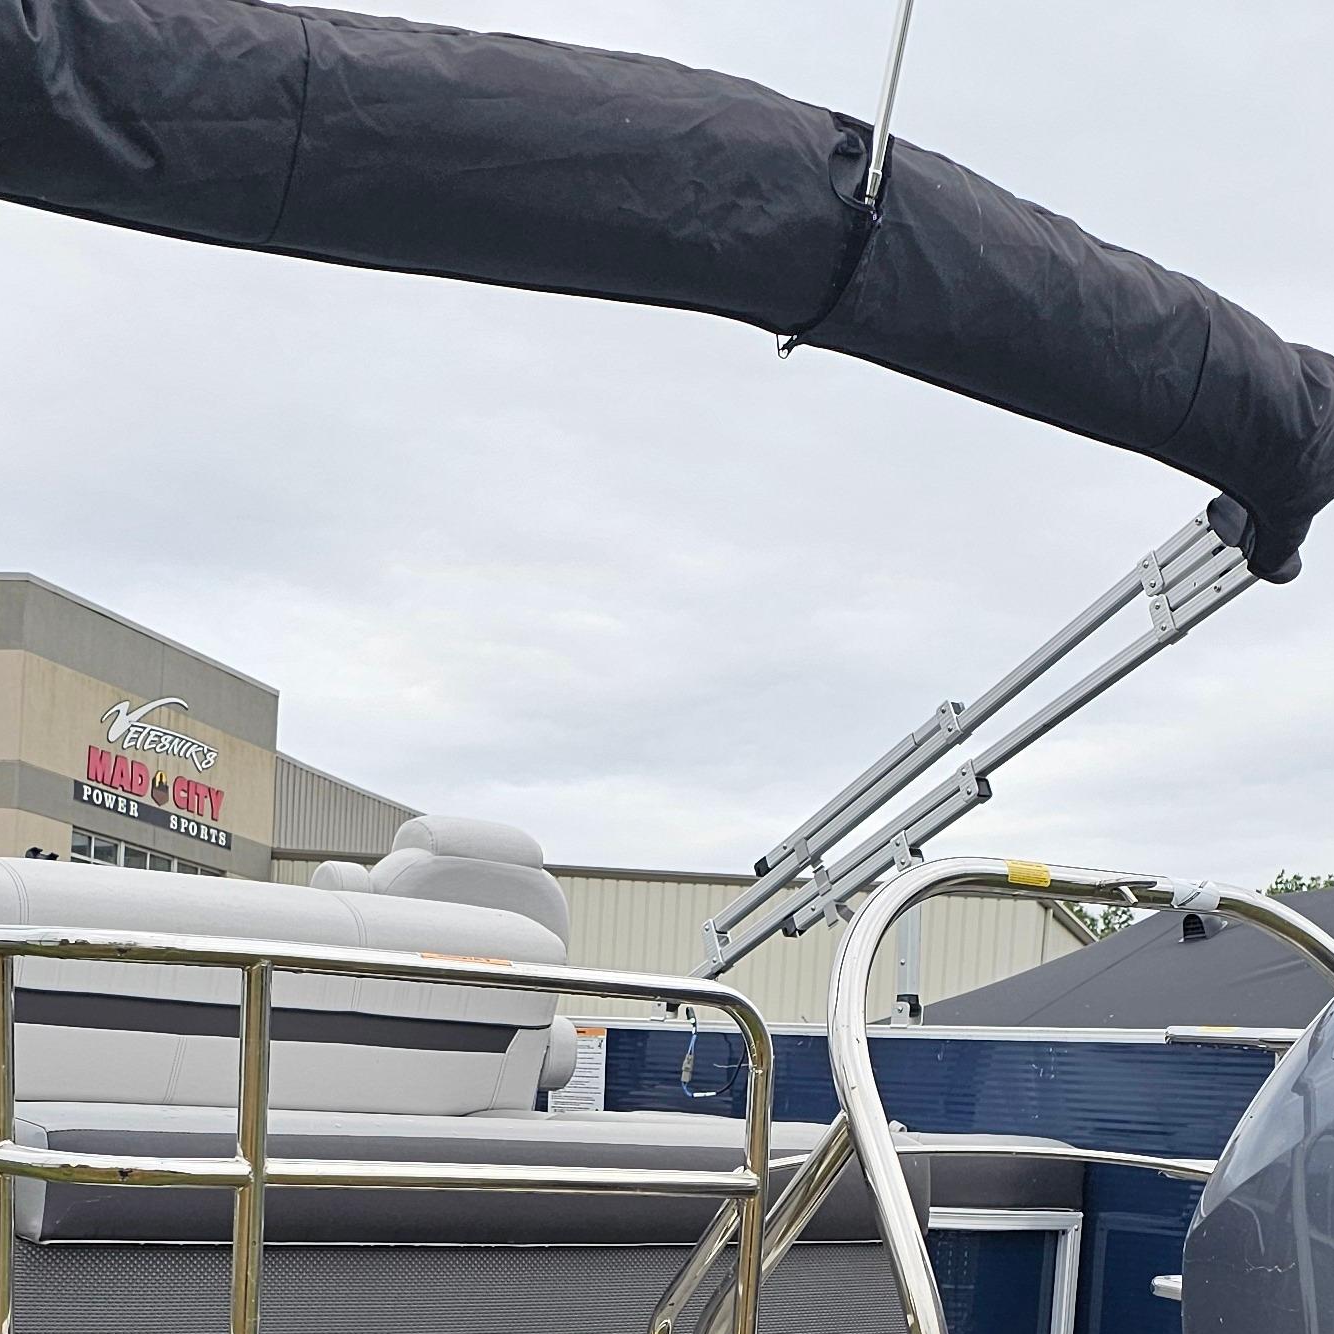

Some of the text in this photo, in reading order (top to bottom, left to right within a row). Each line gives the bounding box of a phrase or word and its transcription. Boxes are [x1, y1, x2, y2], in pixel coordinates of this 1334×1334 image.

[82, 785, 227, 846] POWER SPORTS
[87, 745, 225, 821] MAD CITY
